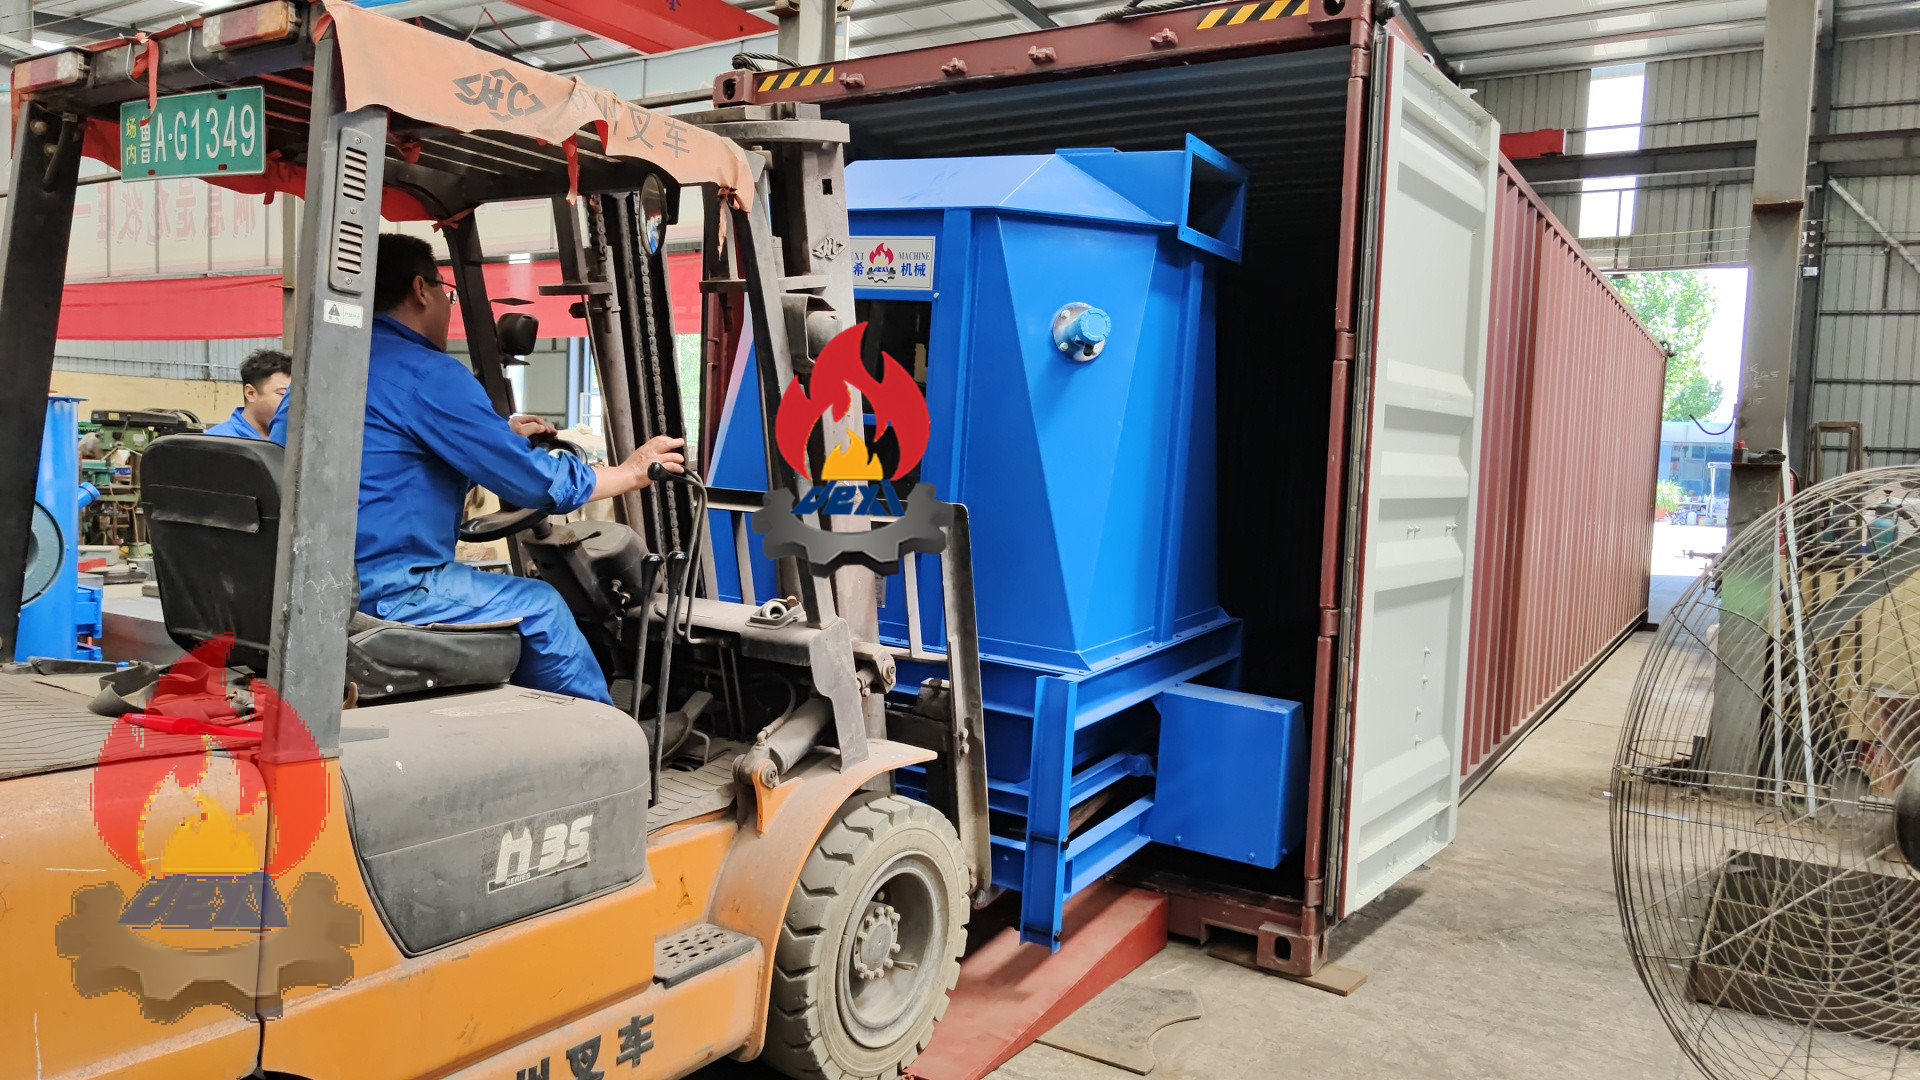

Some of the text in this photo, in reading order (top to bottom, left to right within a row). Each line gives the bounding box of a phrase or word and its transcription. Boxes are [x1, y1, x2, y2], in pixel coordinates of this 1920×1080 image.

[899, 252, 930, 260] MACHINE
[853, 262, 926, 277] 希 机械
[506, 872, 531, 886] SERIES
